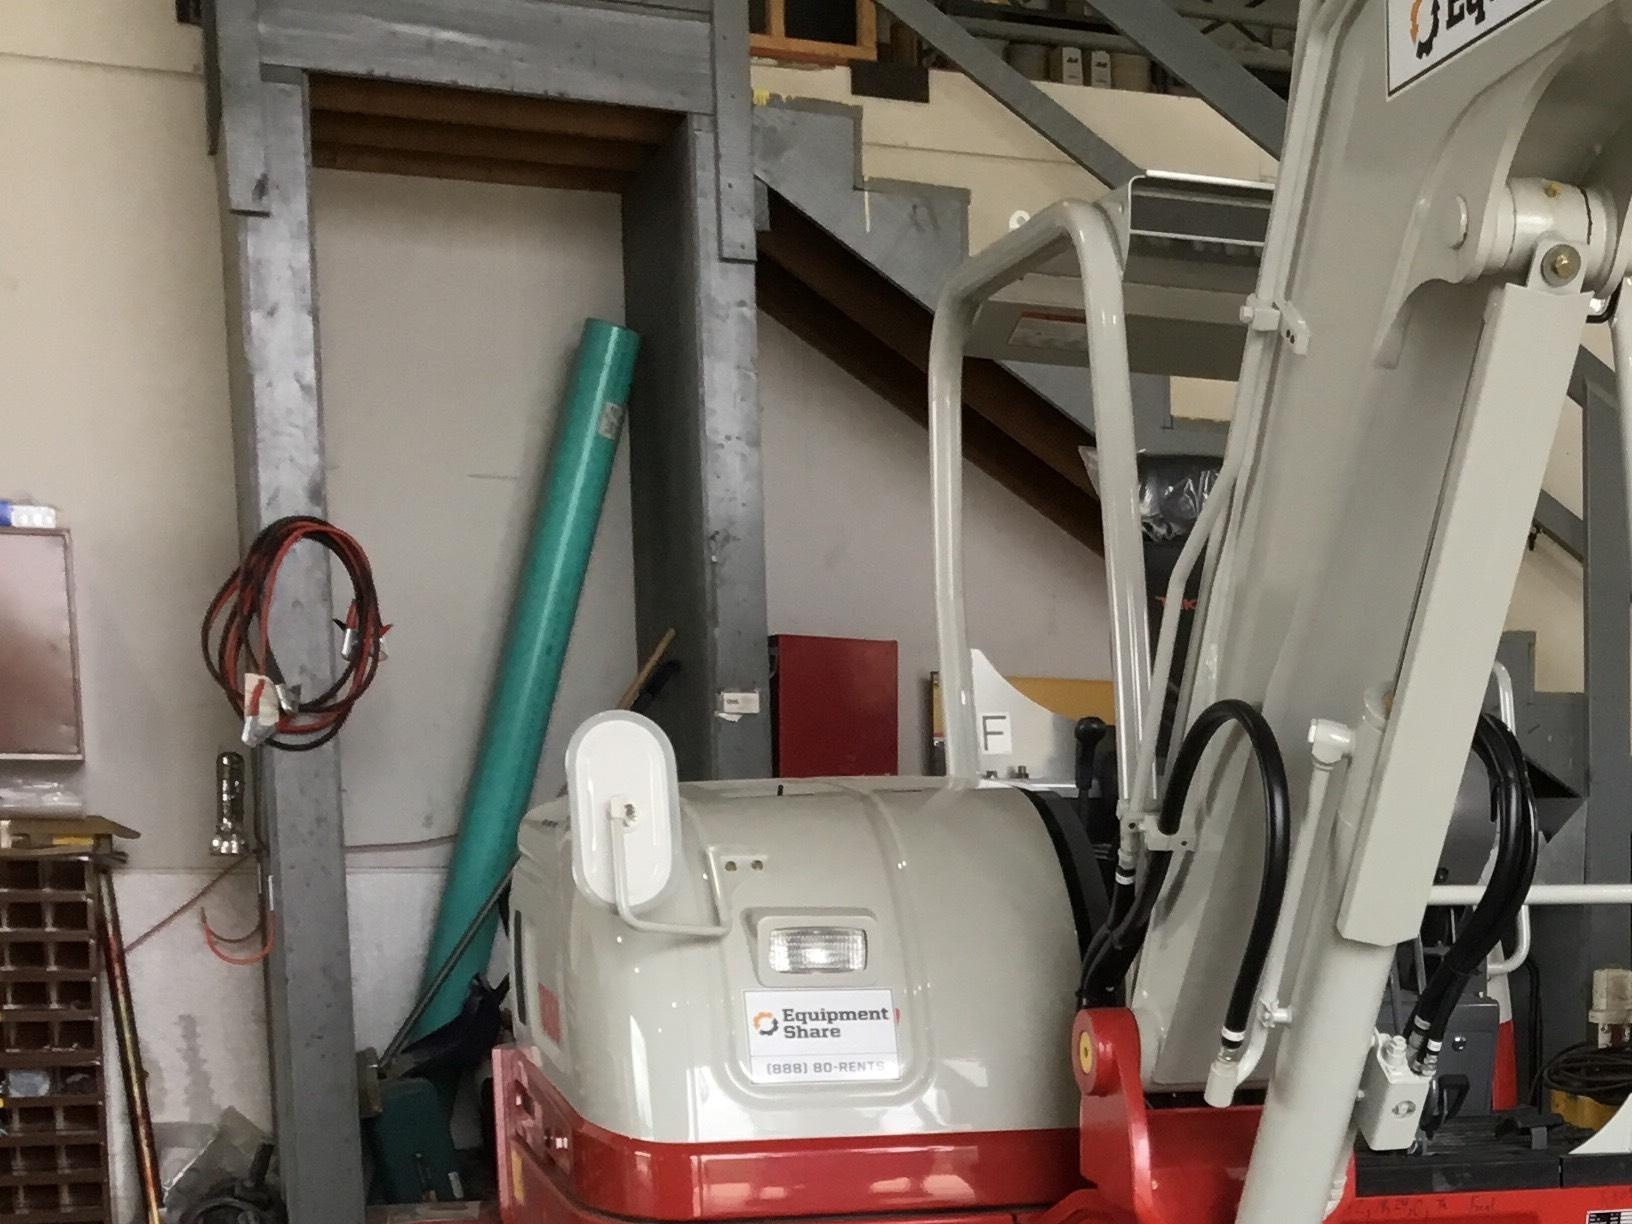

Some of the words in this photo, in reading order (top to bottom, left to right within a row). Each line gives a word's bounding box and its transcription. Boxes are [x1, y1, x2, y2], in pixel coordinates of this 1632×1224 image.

[982, 715, 1007, 751] F
[782, 1007, 889, 1024] Equipment
[783, 1025, 841, 1039] Share
[767, 1063, 808, 1075] (888)
[813, 1060, 886, 1073] 80-RENTS
